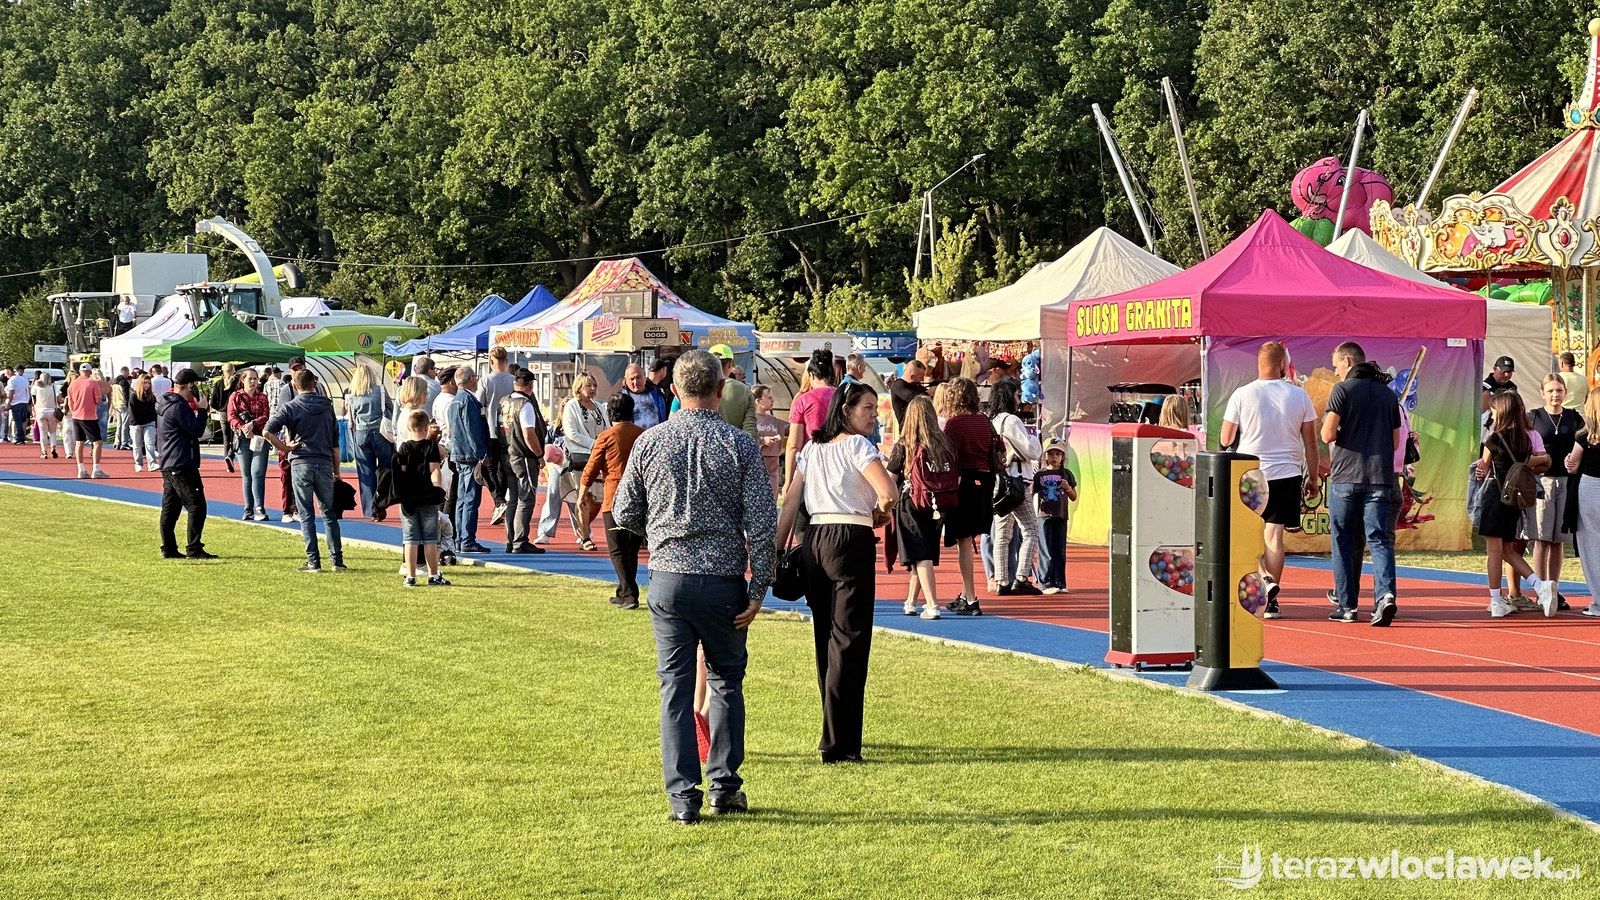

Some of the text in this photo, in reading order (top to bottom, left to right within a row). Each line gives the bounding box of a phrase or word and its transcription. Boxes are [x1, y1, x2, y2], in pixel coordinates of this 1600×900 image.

[1075, 297, 1192, 338] SLUSH GRANITA
[286, 323, 316, 331] CLAAS
[925, 461, 951, 473] VS
